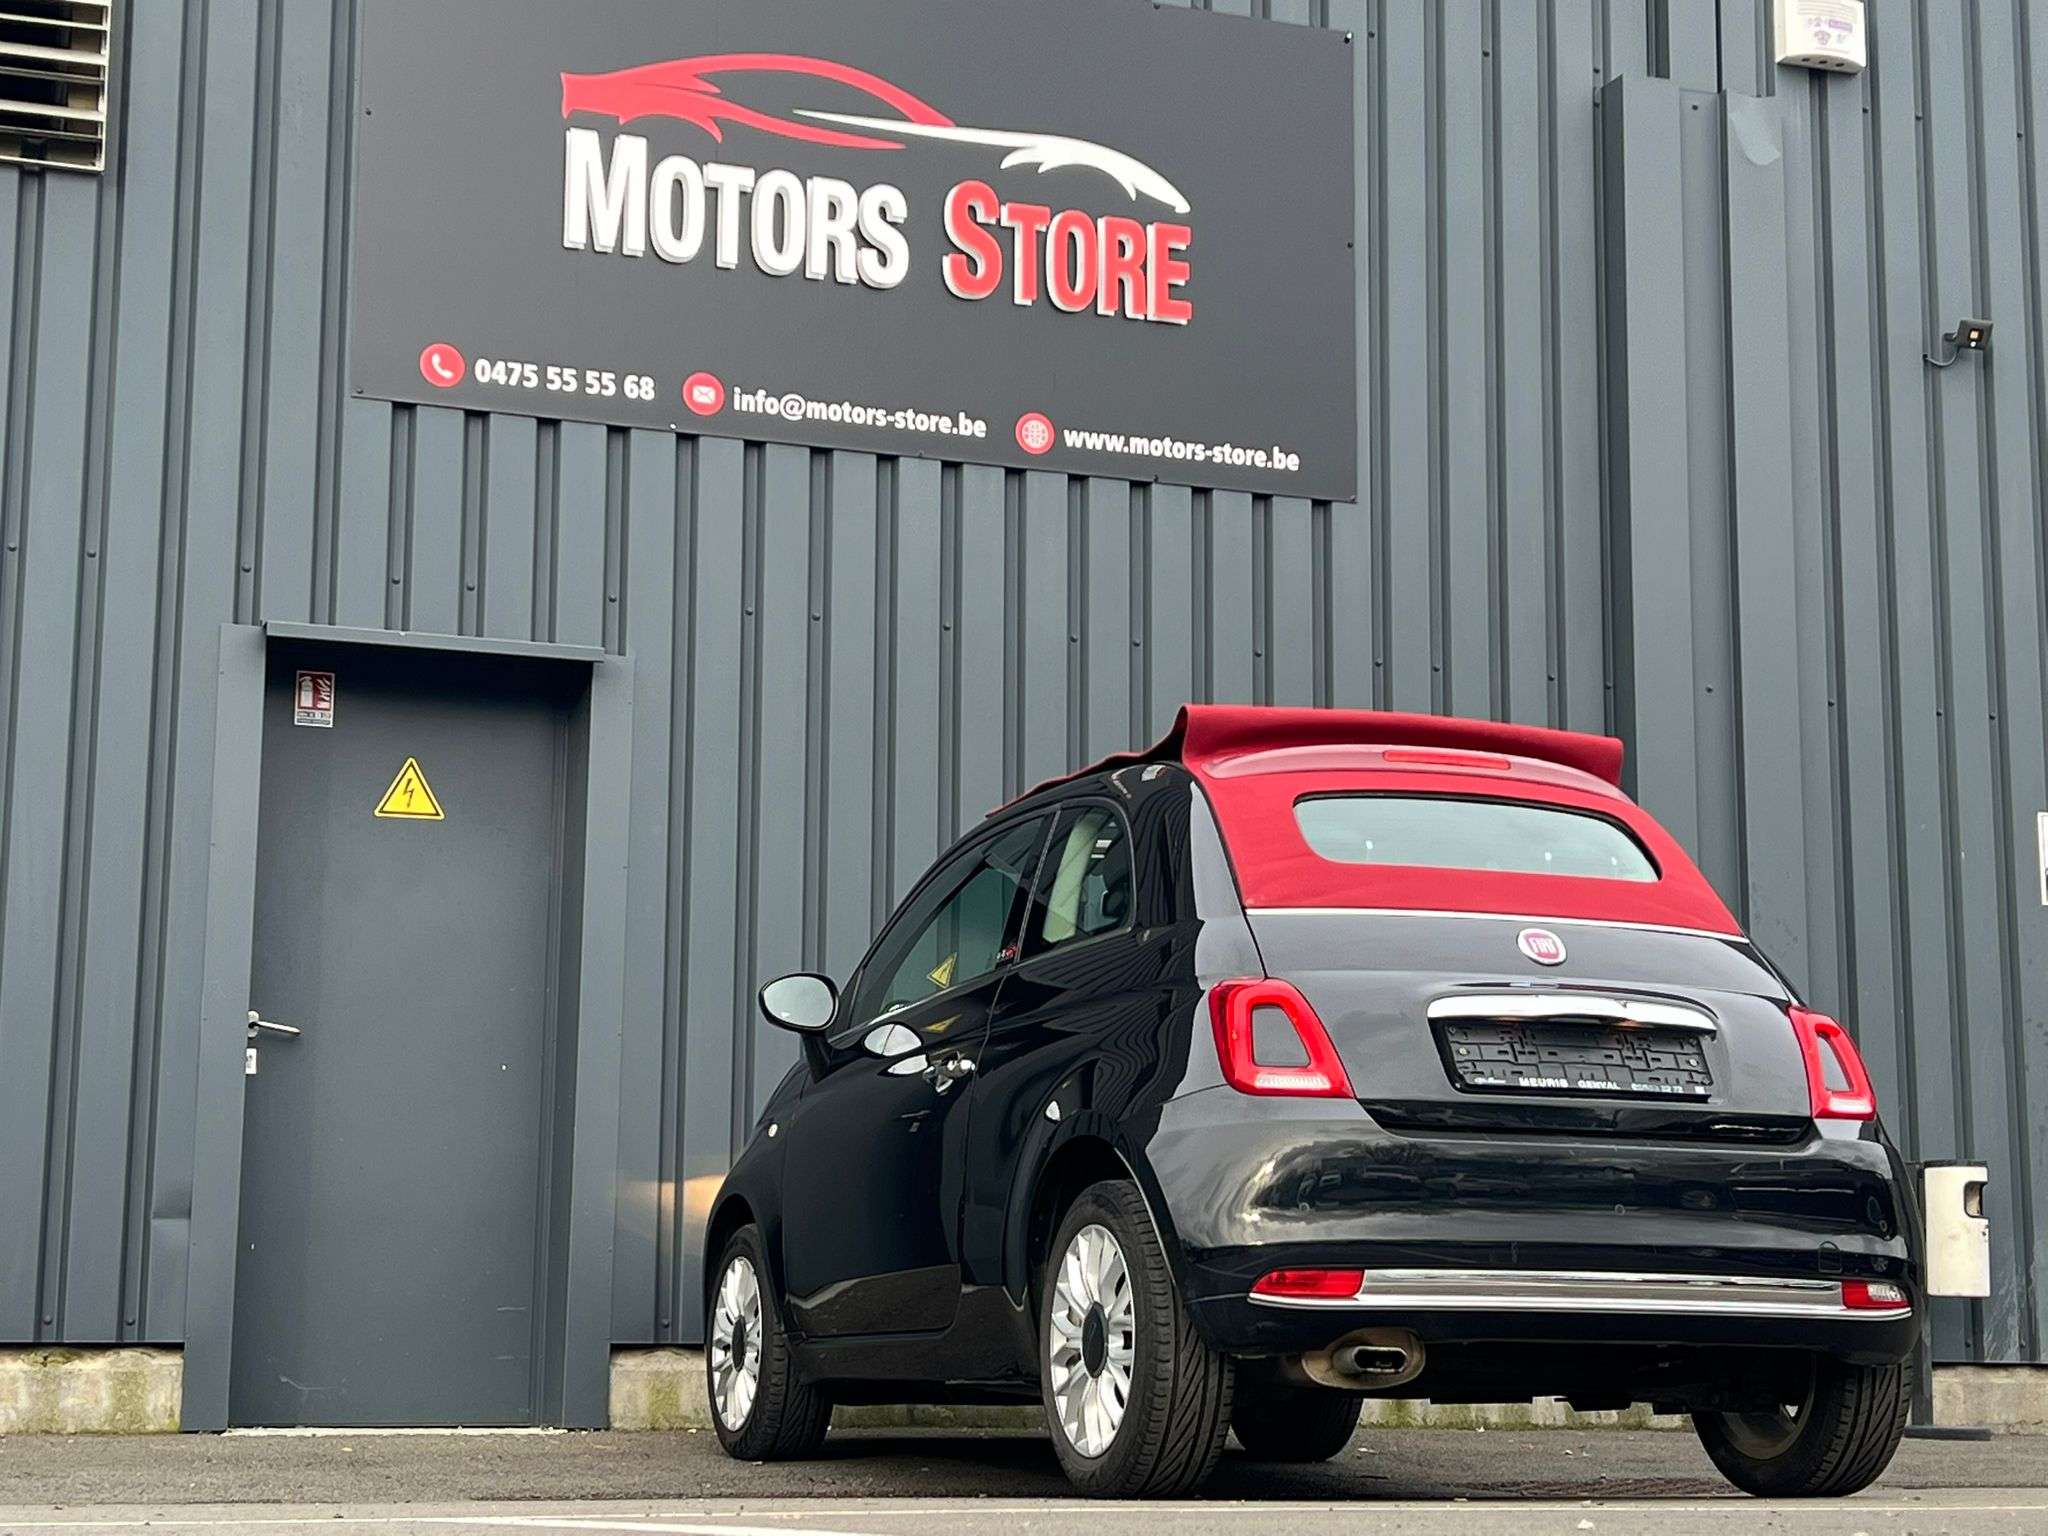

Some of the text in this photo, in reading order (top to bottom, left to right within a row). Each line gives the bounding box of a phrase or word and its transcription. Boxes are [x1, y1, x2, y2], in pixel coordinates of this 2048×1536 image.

[562, 126, 1193, 325] MOTORS STORE
[474, 357, 656, 401] 0475 55 55 68
[732, 385, 987, 440] info@motors-store.be
[1063, 427, 1301, 472] www.motors-store.be
